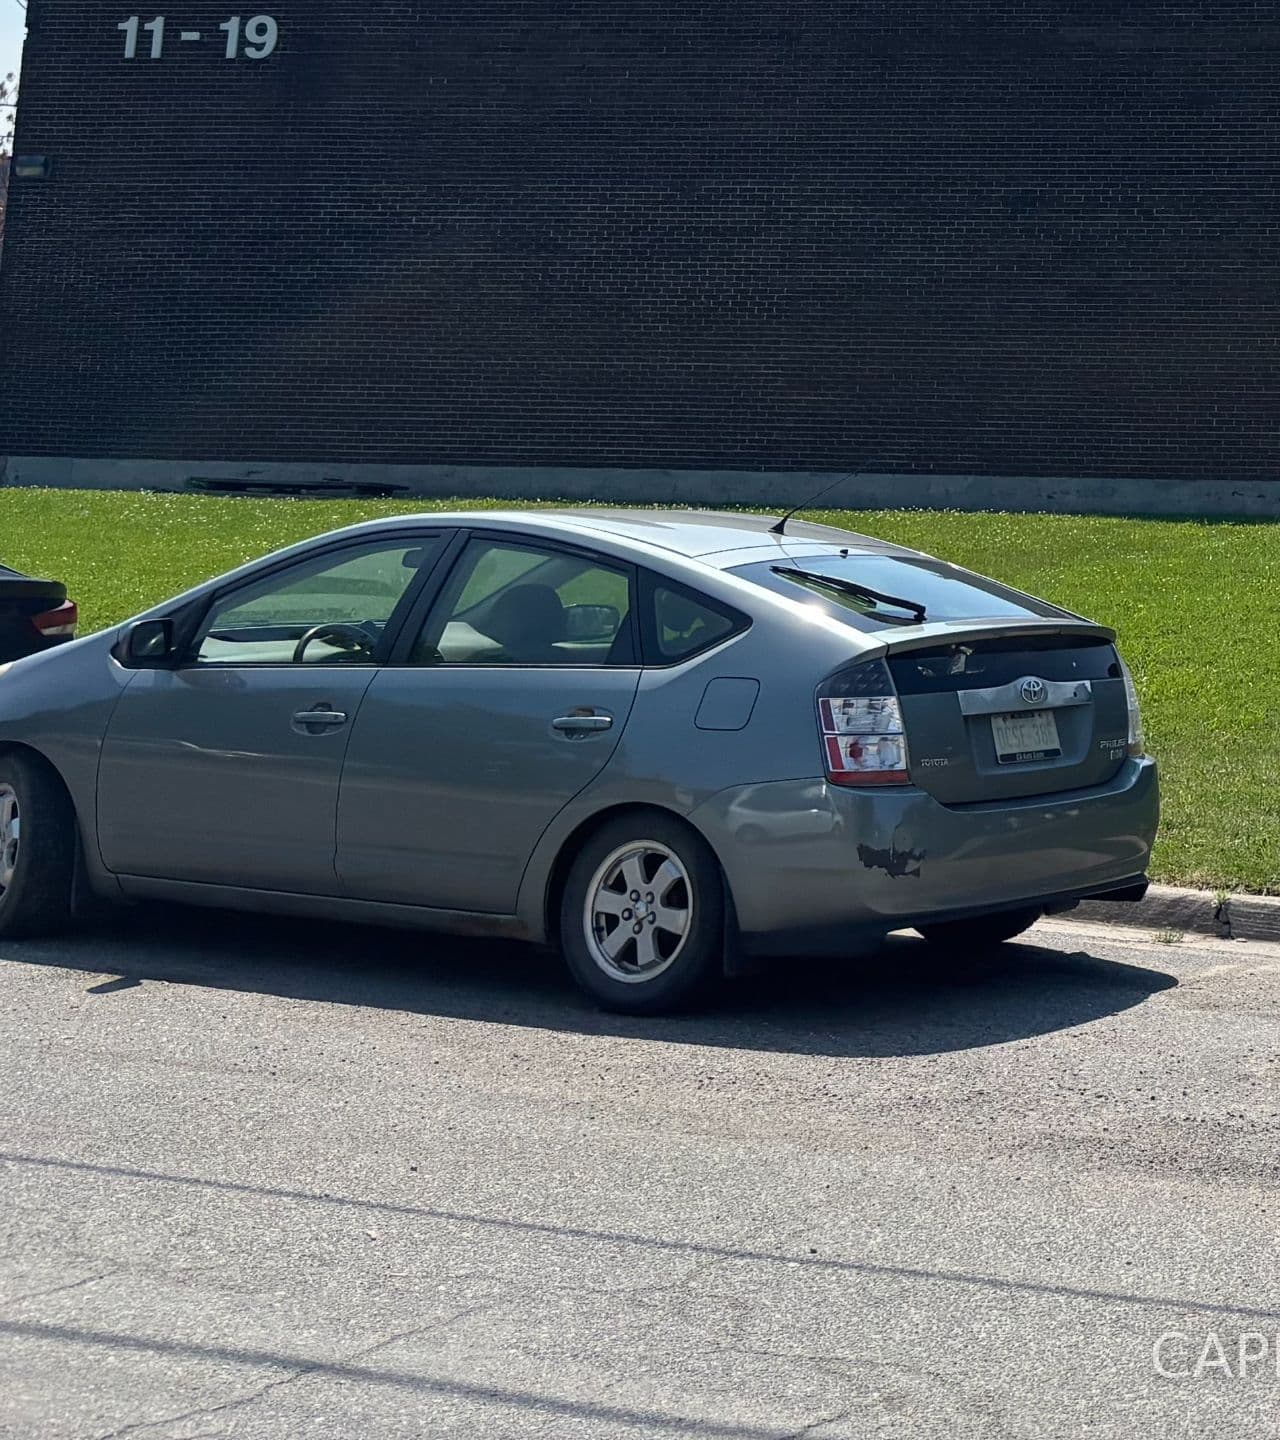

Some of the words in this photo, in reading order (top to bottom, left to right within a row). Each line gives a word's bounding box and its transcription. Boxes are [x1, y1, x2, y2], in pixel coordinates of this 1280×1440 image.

[117, 15, 165, 59] 11
[180, 31, 201, 41] -
[219, 14, 279, 59] 19
